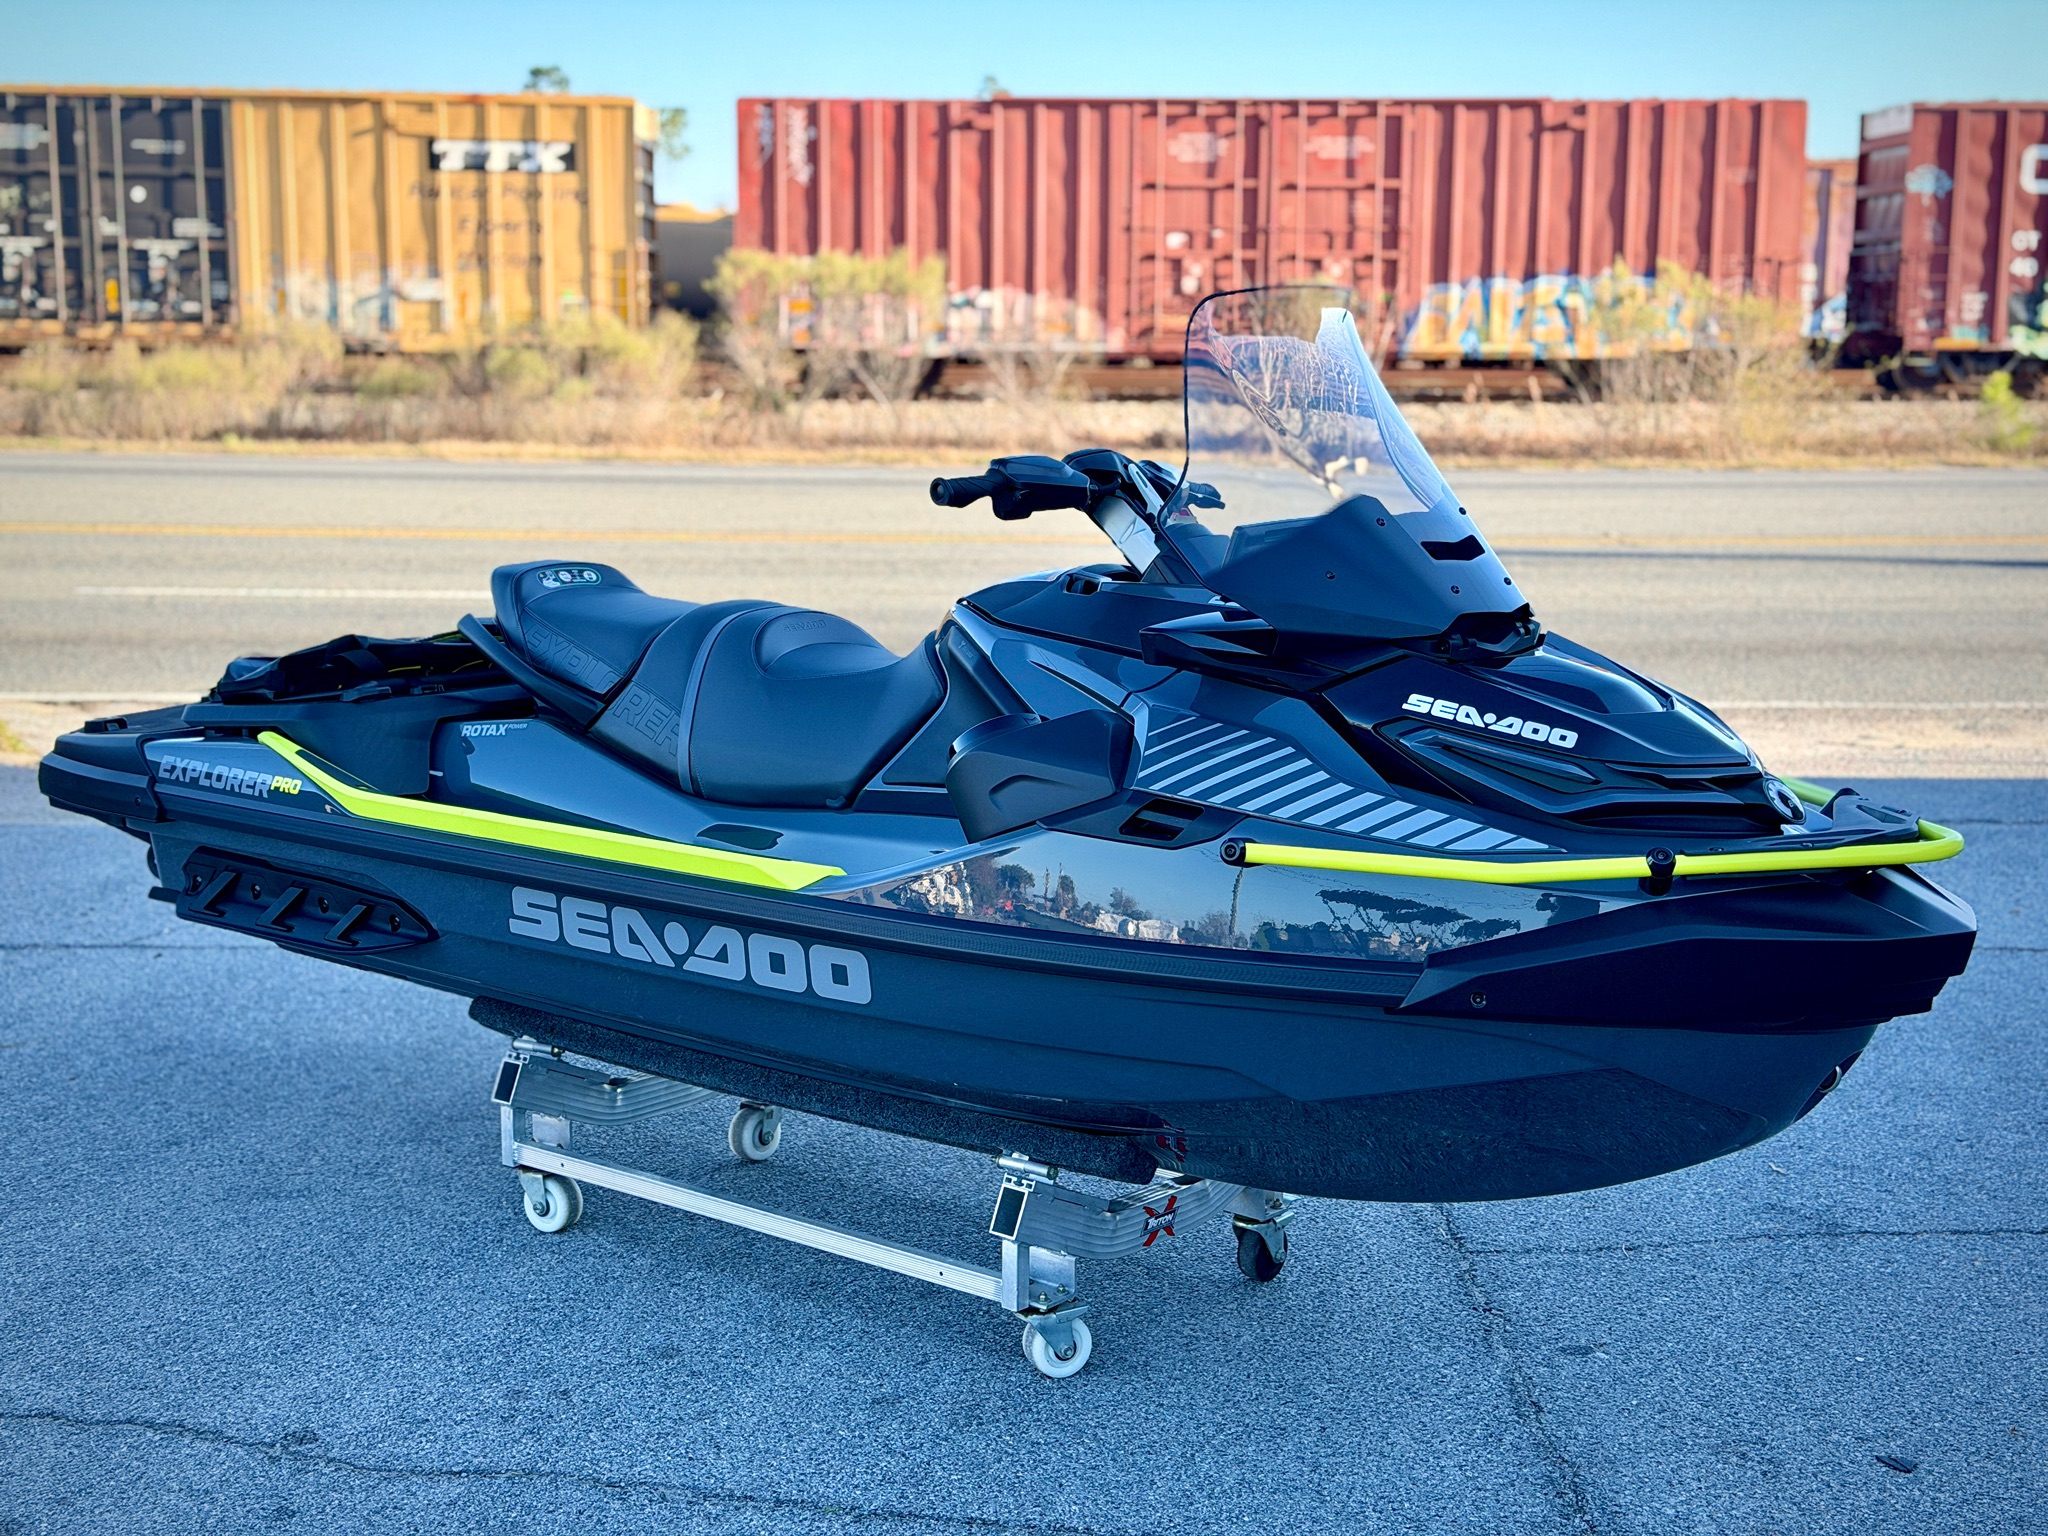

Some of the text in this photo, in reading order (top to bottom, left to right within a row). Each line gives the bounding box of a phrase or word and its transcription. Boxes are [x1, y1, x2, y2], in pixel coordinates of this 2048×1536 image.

[433, 141, 571, 172] TTX
[461, 724, 508, 737] ROTAX
[158, 755, 303, 798] EXPLORER PRO
[1148, 1213, 1174, 1229] TRITON
